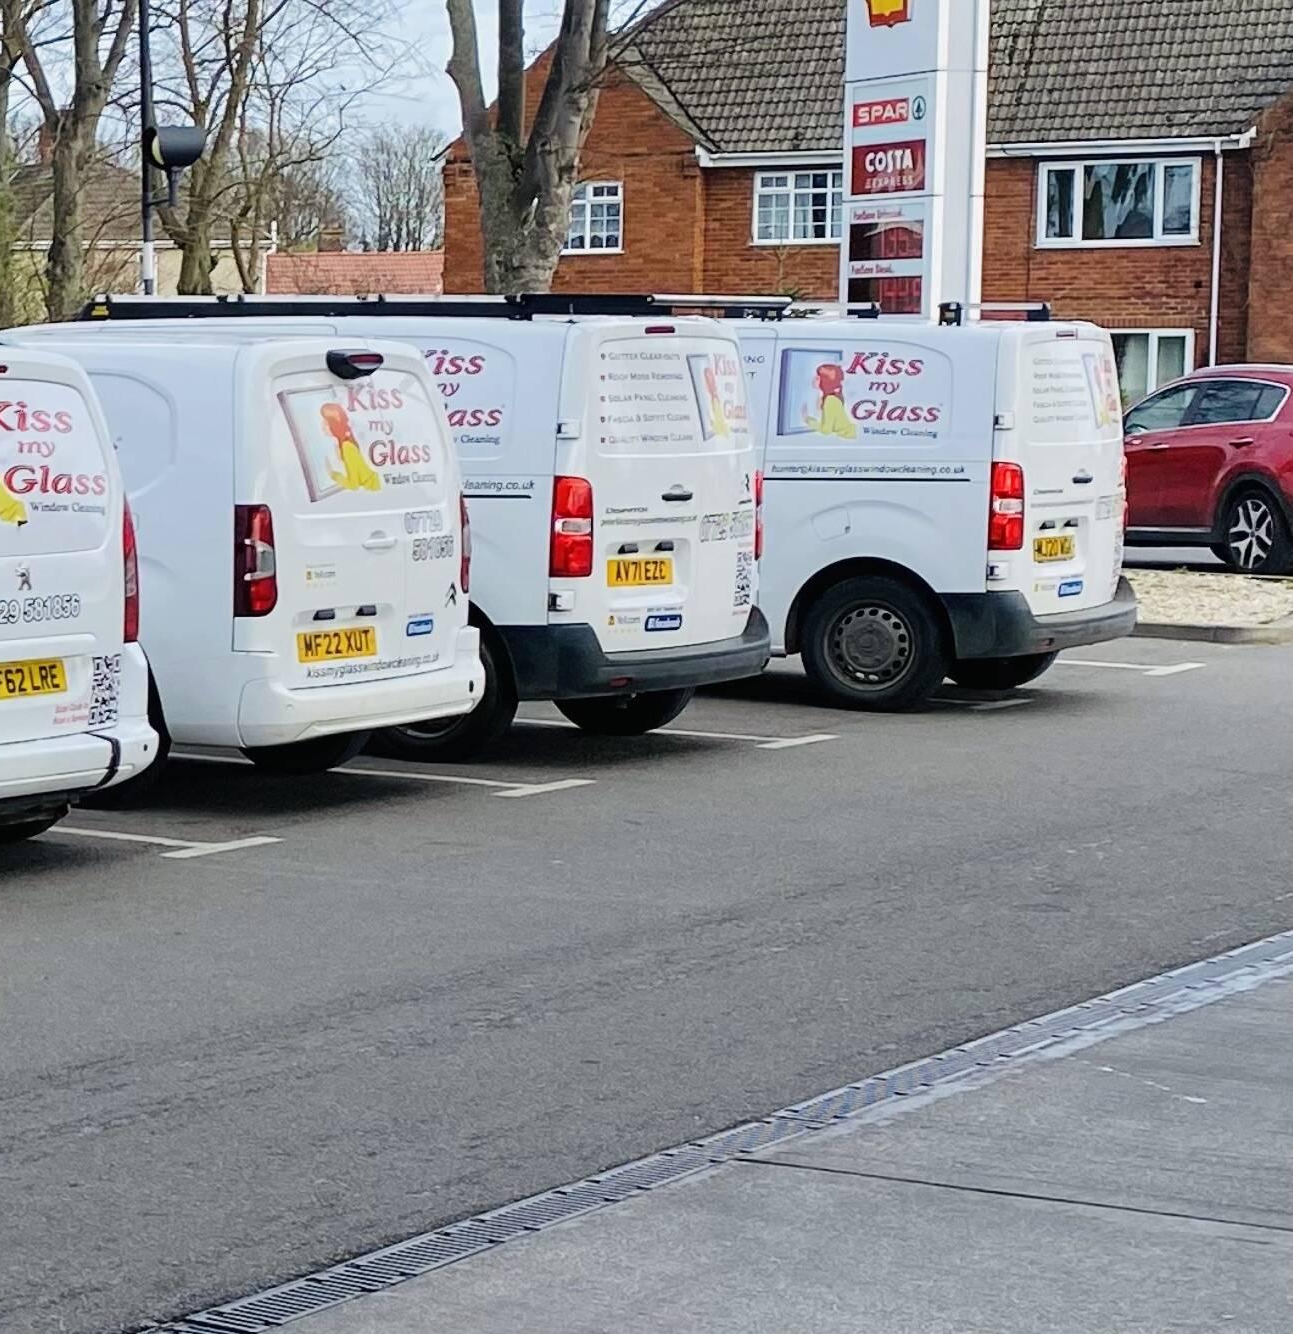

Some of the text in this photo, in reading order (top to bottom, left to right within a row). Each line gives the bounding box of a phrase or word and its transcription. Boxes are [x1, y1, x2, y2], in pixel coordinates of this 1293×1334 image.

[857, 101, 908, 123] SPAR
[865, 147, 913, 173] COSTA
[845, 351, 924, 377] Kiss
[345, 382, 404, 413] Kiss
[867, 379, 900, 395] my
[850, 400, 941, 423] Glass
[367, 418, 394, 436] my
[17, 437, 56, 458] my
[368, 439, 432, 467] Glass
[3, 465, 106, 496] Glass
[615, 561, 642, 582] AV71
[22, 593, 81, 623] 581856
[304, 629, 370, 657] MF22 XUT
[29, 665, 61, 693] LRE
